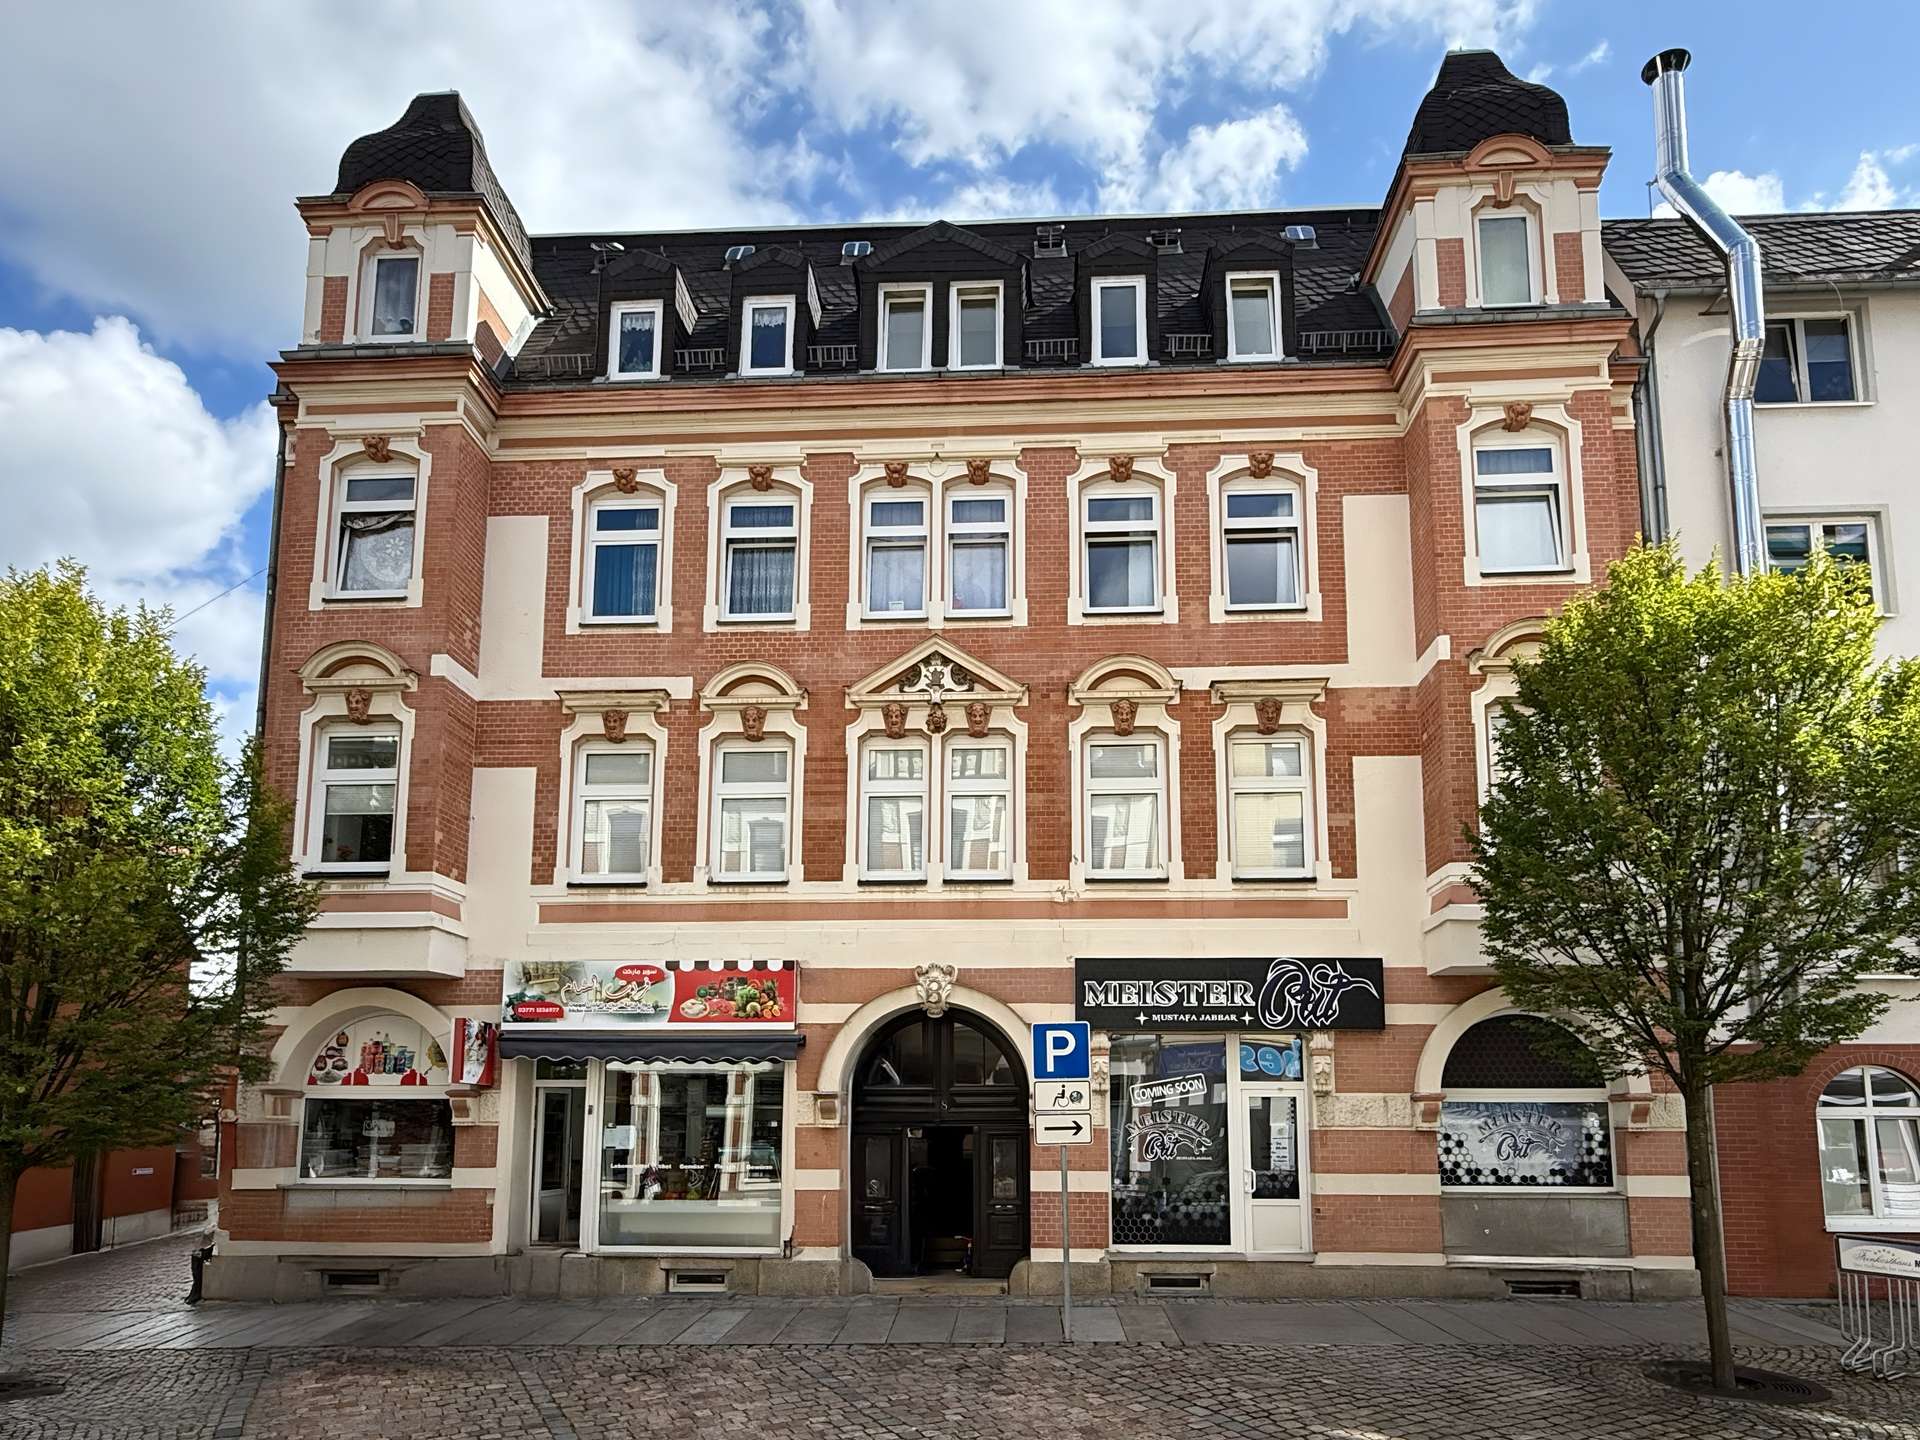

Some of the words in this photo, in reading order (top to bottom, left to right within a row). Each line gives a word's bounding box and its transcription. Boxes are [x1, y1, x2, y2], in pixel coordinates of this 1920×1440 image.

[1084, 980, 1256, 1007] MEISTER
[1152, 1014, 1197, 1022] MUSTAFA
[1199, 1014, 1238, 1022] JABBAR
[1046, 1030, 1076, 1073] P
[1134, 1083, 1174, 1100] COMING
[1175, 1079, 1203, 1093] SOON
[1125, 1110, 1210, 1137] MEISTER
[1477, 1111, 1562, 1136] MEISTER
